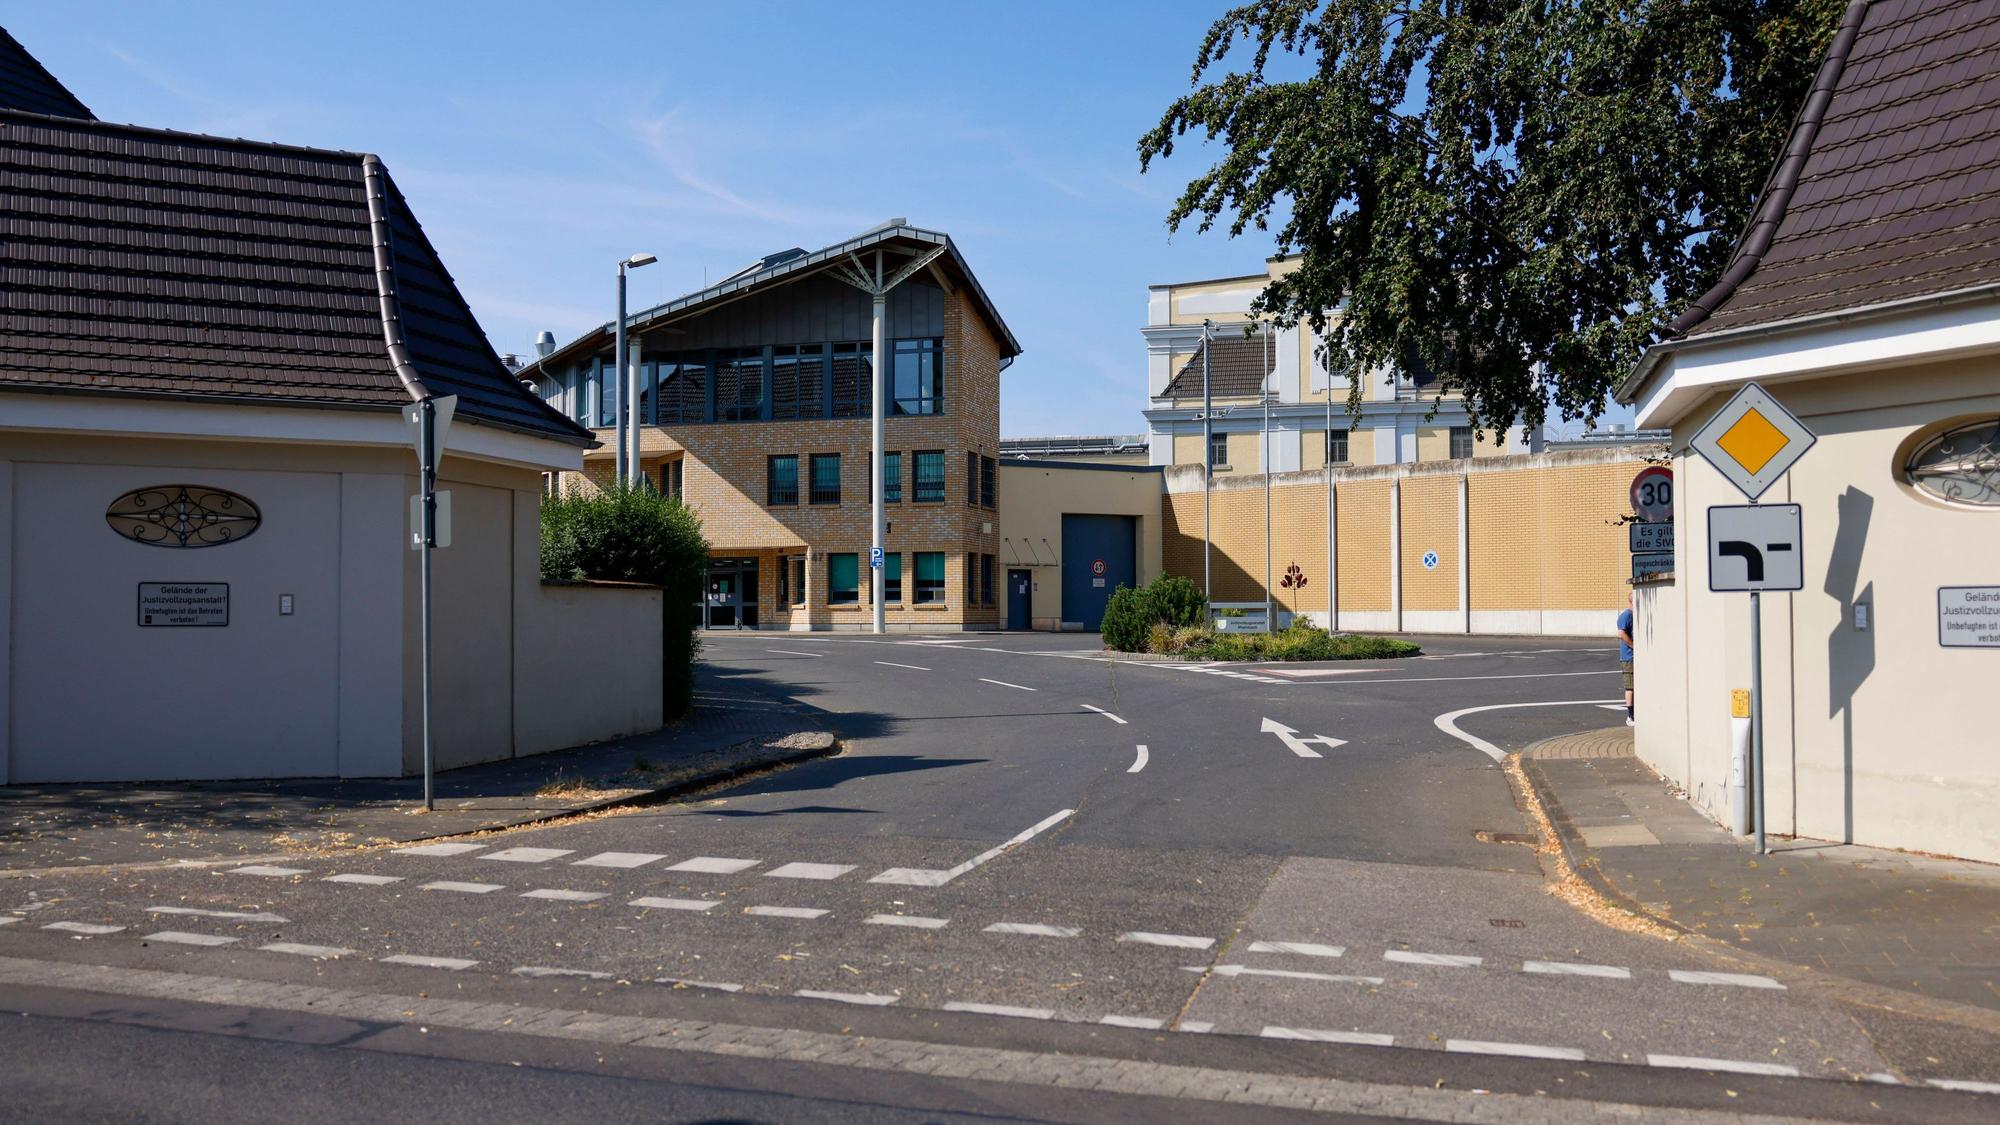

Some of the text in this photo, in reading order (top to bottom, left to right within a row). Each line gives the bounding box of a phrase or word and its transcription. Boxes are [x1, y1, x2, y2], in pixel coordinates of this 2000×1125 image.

[1641, 482, 1672, 507] 30
[1641, 526, 1673, 538] Es gilt
[1636, 539, 1651, 548] die
[161, 586, 208, 594] Gelände der
[198, 607, 223, 615] Betreten
[1947, 621, 1998, 632] Unbefugten ist
